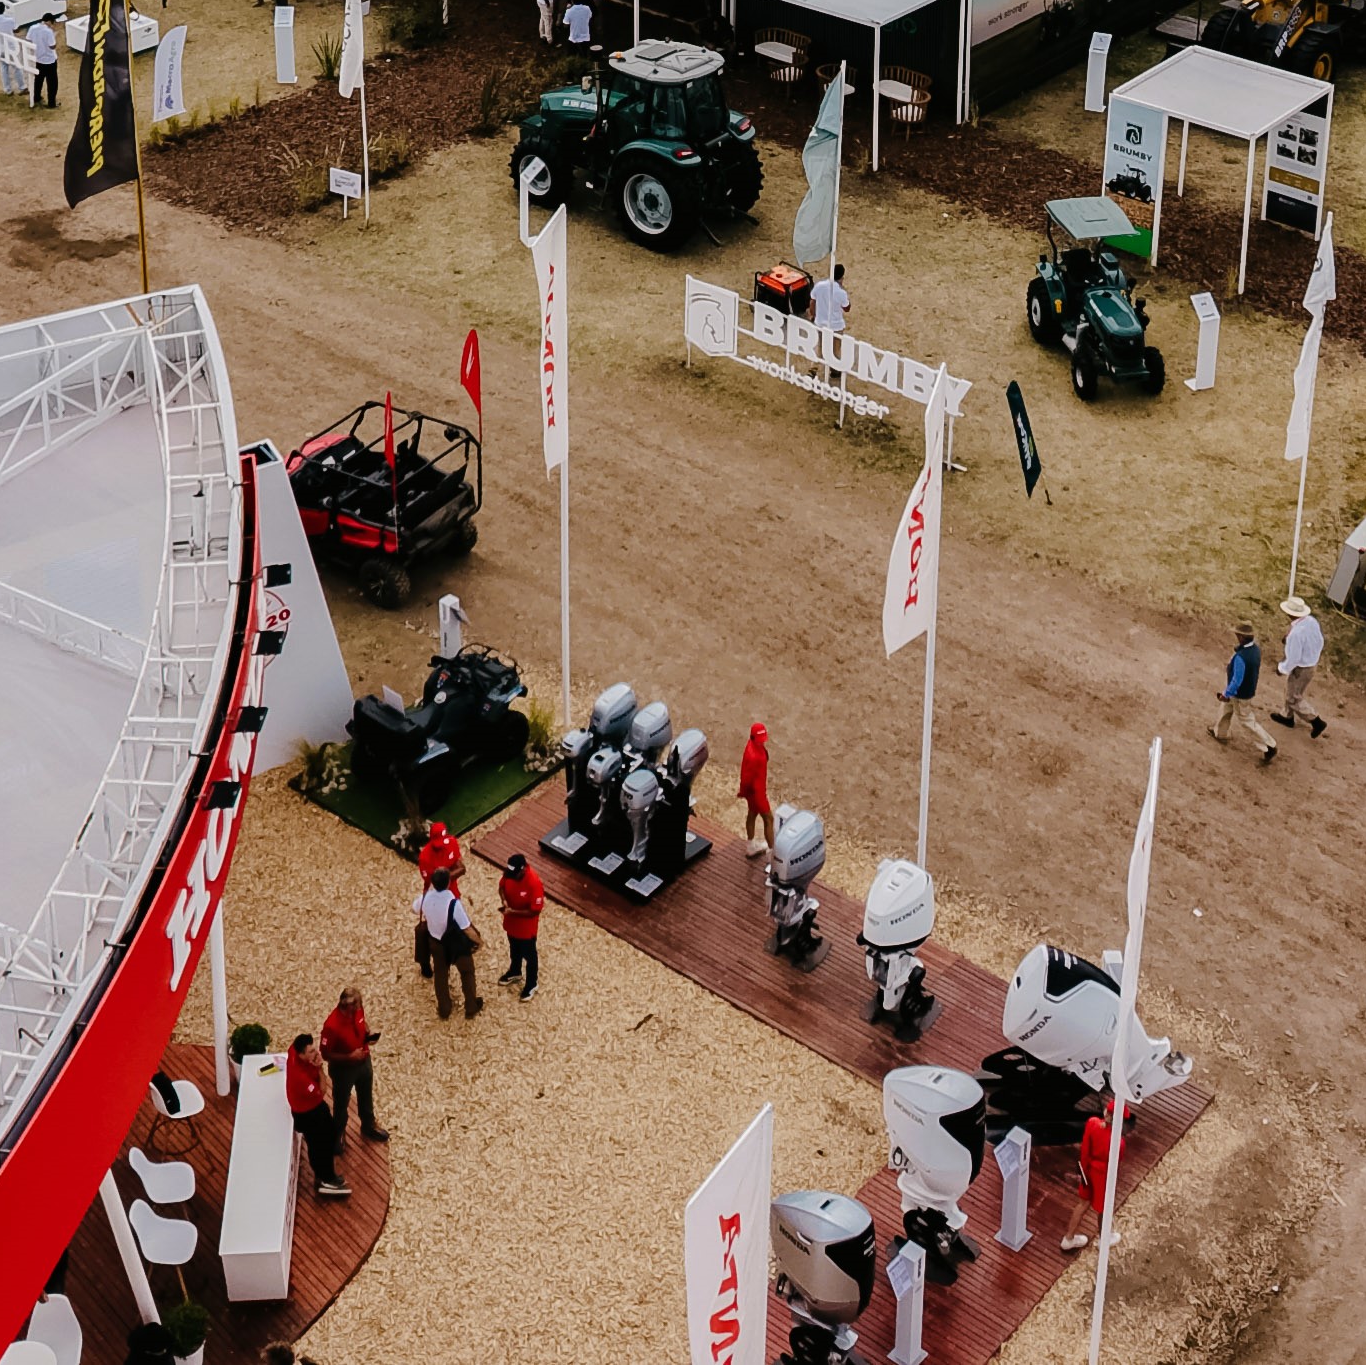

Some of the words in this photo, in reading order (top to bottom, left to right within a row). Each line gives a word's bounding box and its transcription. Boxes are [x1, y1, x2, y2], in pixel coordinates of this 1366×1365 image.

[988, 12, 1003, 27] work
[1003, 0, 1030, 21] stronger
[1113, 143, 1153, 162] BRUMBY
[753, 300, 973, 418] BRUMBY
[788, 840, 824, 866] HONDA
[889, 903, 925, 926] HONDA
[1018, 1015, 1053, 1043] HONDA
[893, 1098, 925, 1127] HONDA
[778, 1224, 811, 1257] HONDA
